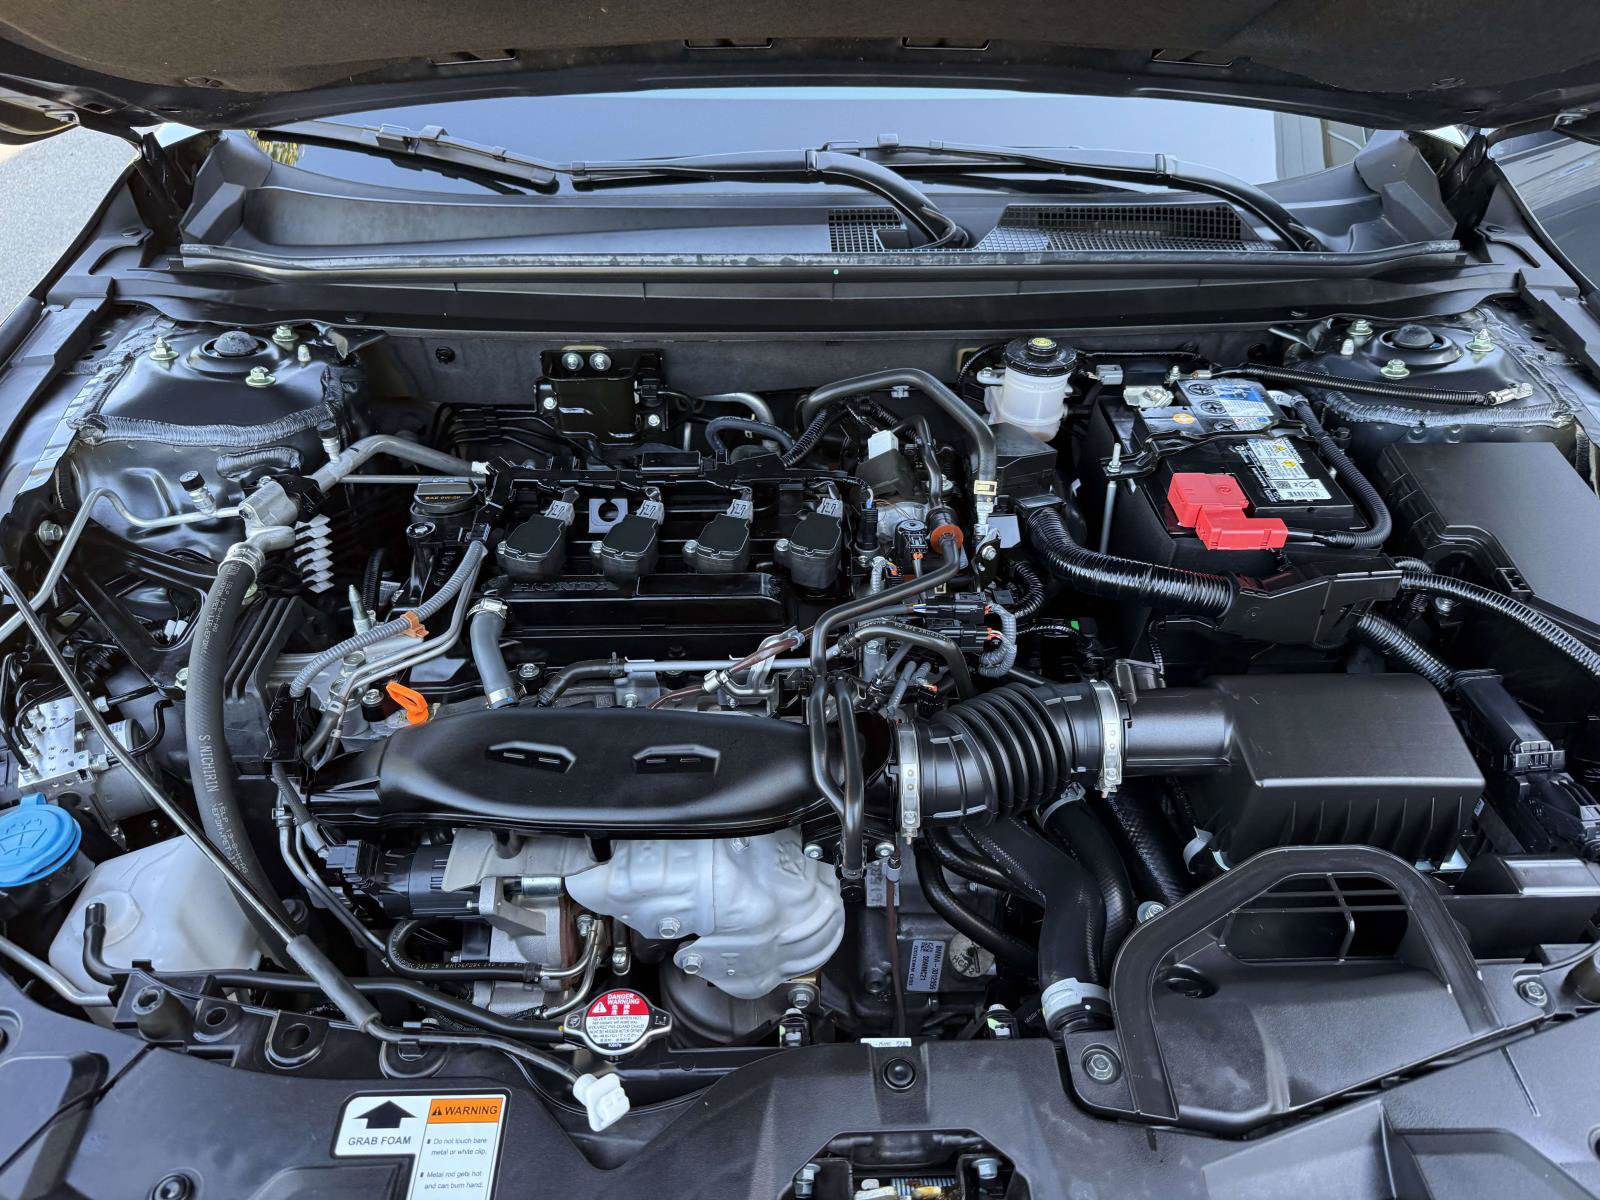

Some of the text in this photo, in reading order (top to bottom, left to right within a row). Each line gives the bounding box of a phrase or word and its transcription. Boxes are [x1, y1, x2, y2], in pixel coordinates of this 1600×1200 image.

[511, 581, 619, 592] HONDA
[199, 745, 220, 793] NICHIRIN
[445, 1105, 498, 1116] WARNING
[348, 1135, 411, 1146] GRAB FOAM
[456, 1171, 470, 1179] gets
